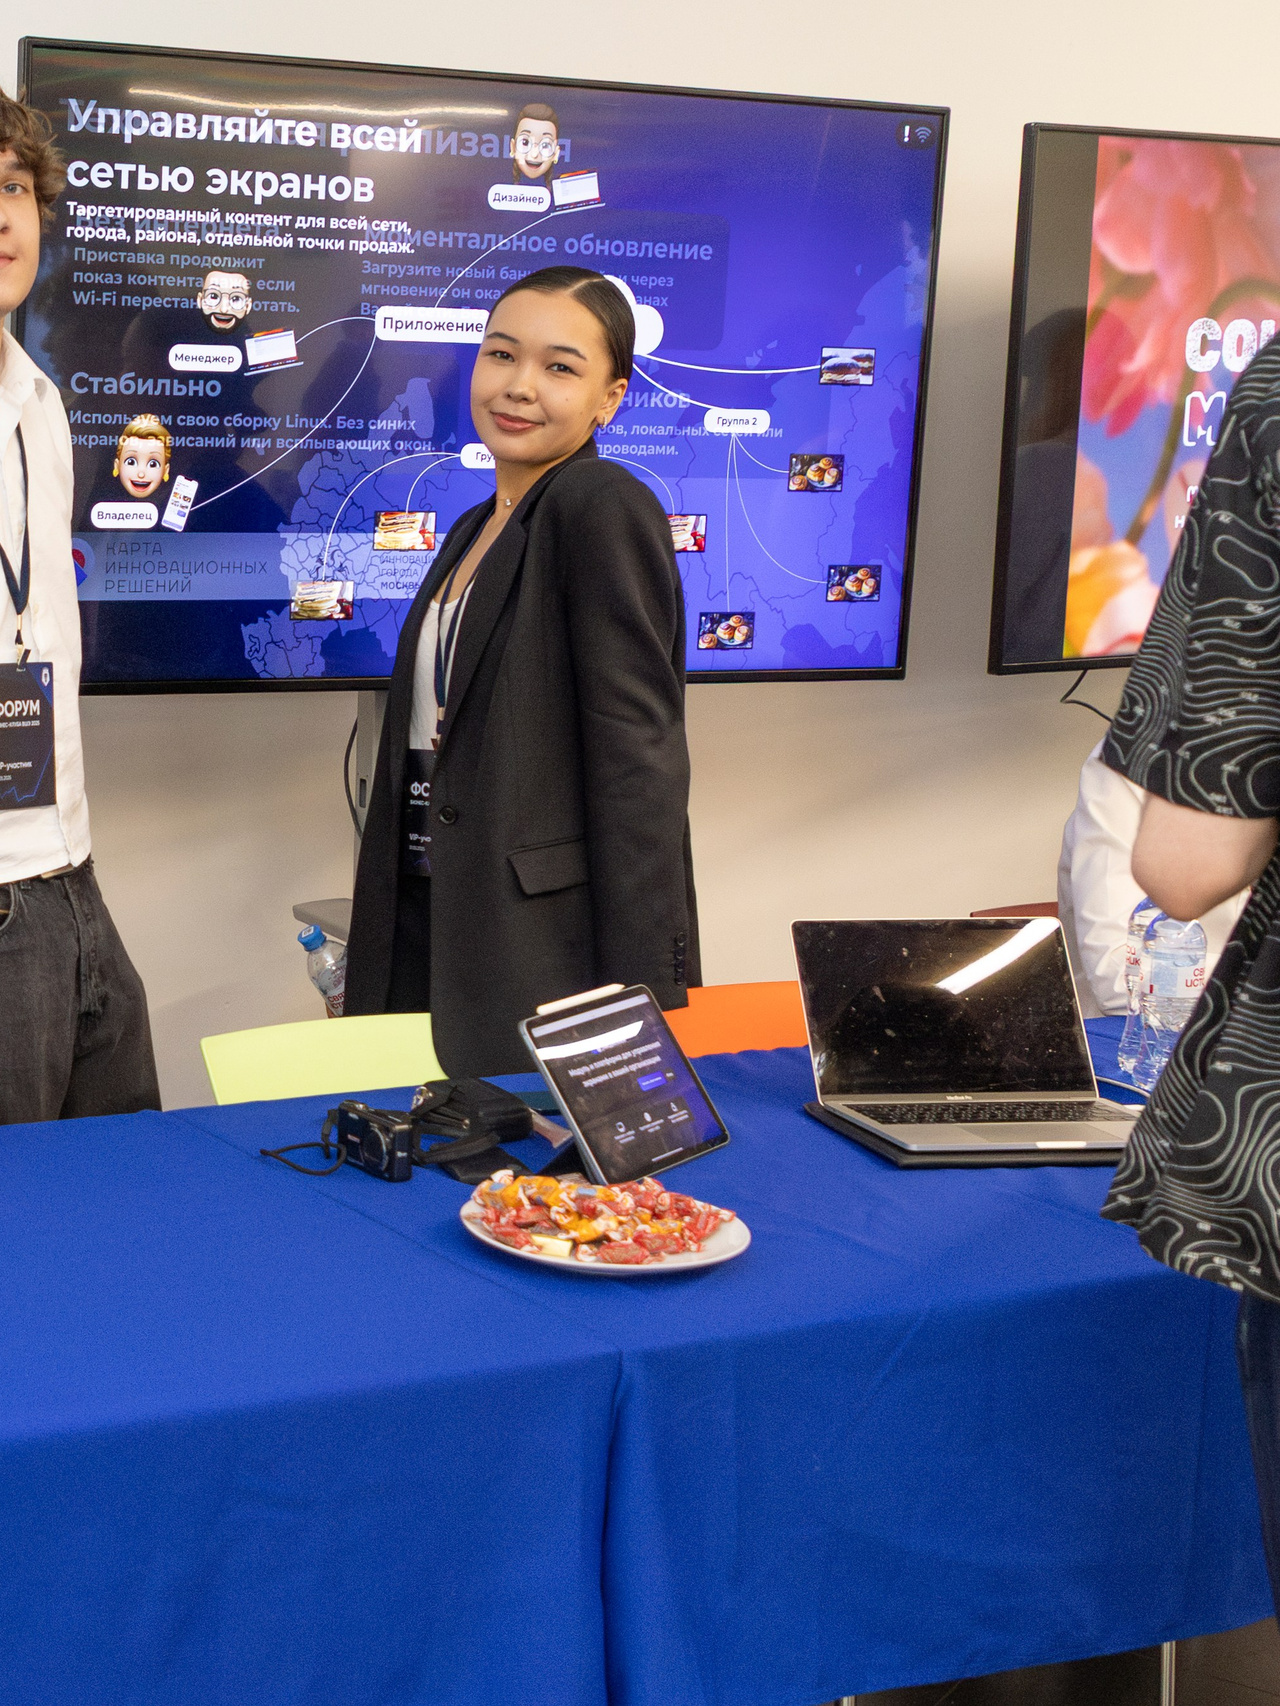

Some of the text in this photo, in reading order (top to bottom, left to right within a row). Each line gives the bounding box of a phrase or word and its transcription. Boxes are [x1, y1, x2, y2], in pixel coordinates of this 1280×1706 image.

[68, 98, 423, 153] Управляйте всей
[67, 160, 375, 205] сетью экранов
[492, 192, 545, 206] Дизайнер
[66, 201, 412, 234] Таргетированный контент для всей сети,
[66, 226, 415, 254] города, района, отдельной точки продаж.
[564, 232, 713, 261] обновление
[74, 247, 266, 269] Приставка продолжит
[361, 260, 442, 278] Загрузите
[445, 265, 496, 280] новый
[73, 271, 123, 285] показ
[127, 273, 204, 288] контента
[256, 278, 296, 292] если
[631, 275, 674, 290] через
[360, 283, 447, 298] мгновение
[451, 286, 471, 299] он
[72, 290, 301, 313] Wi-Fi перестан отать.
[382, 316, 484, 332] Приложение
[174, 352, 235, 365] Менеджер
[70, 371, 222, 397] Стабильно
[177, 415, 220, 427] свою
[223, 412, 282, 431] сборку
[285, 414, 332, 430] Linux.
[336, 416, 364, 430] Без
[368, 418, 416, 431] синих
[717, 416, 758, 427] Группа 2
[630, 424, 710, 437] локальных
[241, 436, 272, 449] или
[276, 437, 391, 452] всплывающих
[394, 439, 436, 451] окон.
[97, 510, 153, 522] Владелец
[106, 542, 163, 556] КАРТА
[104, 560, 268, 575] ИННОВАЦИОННЫХ
[104, 576, 192, 593] РЕШЕНИЙ
